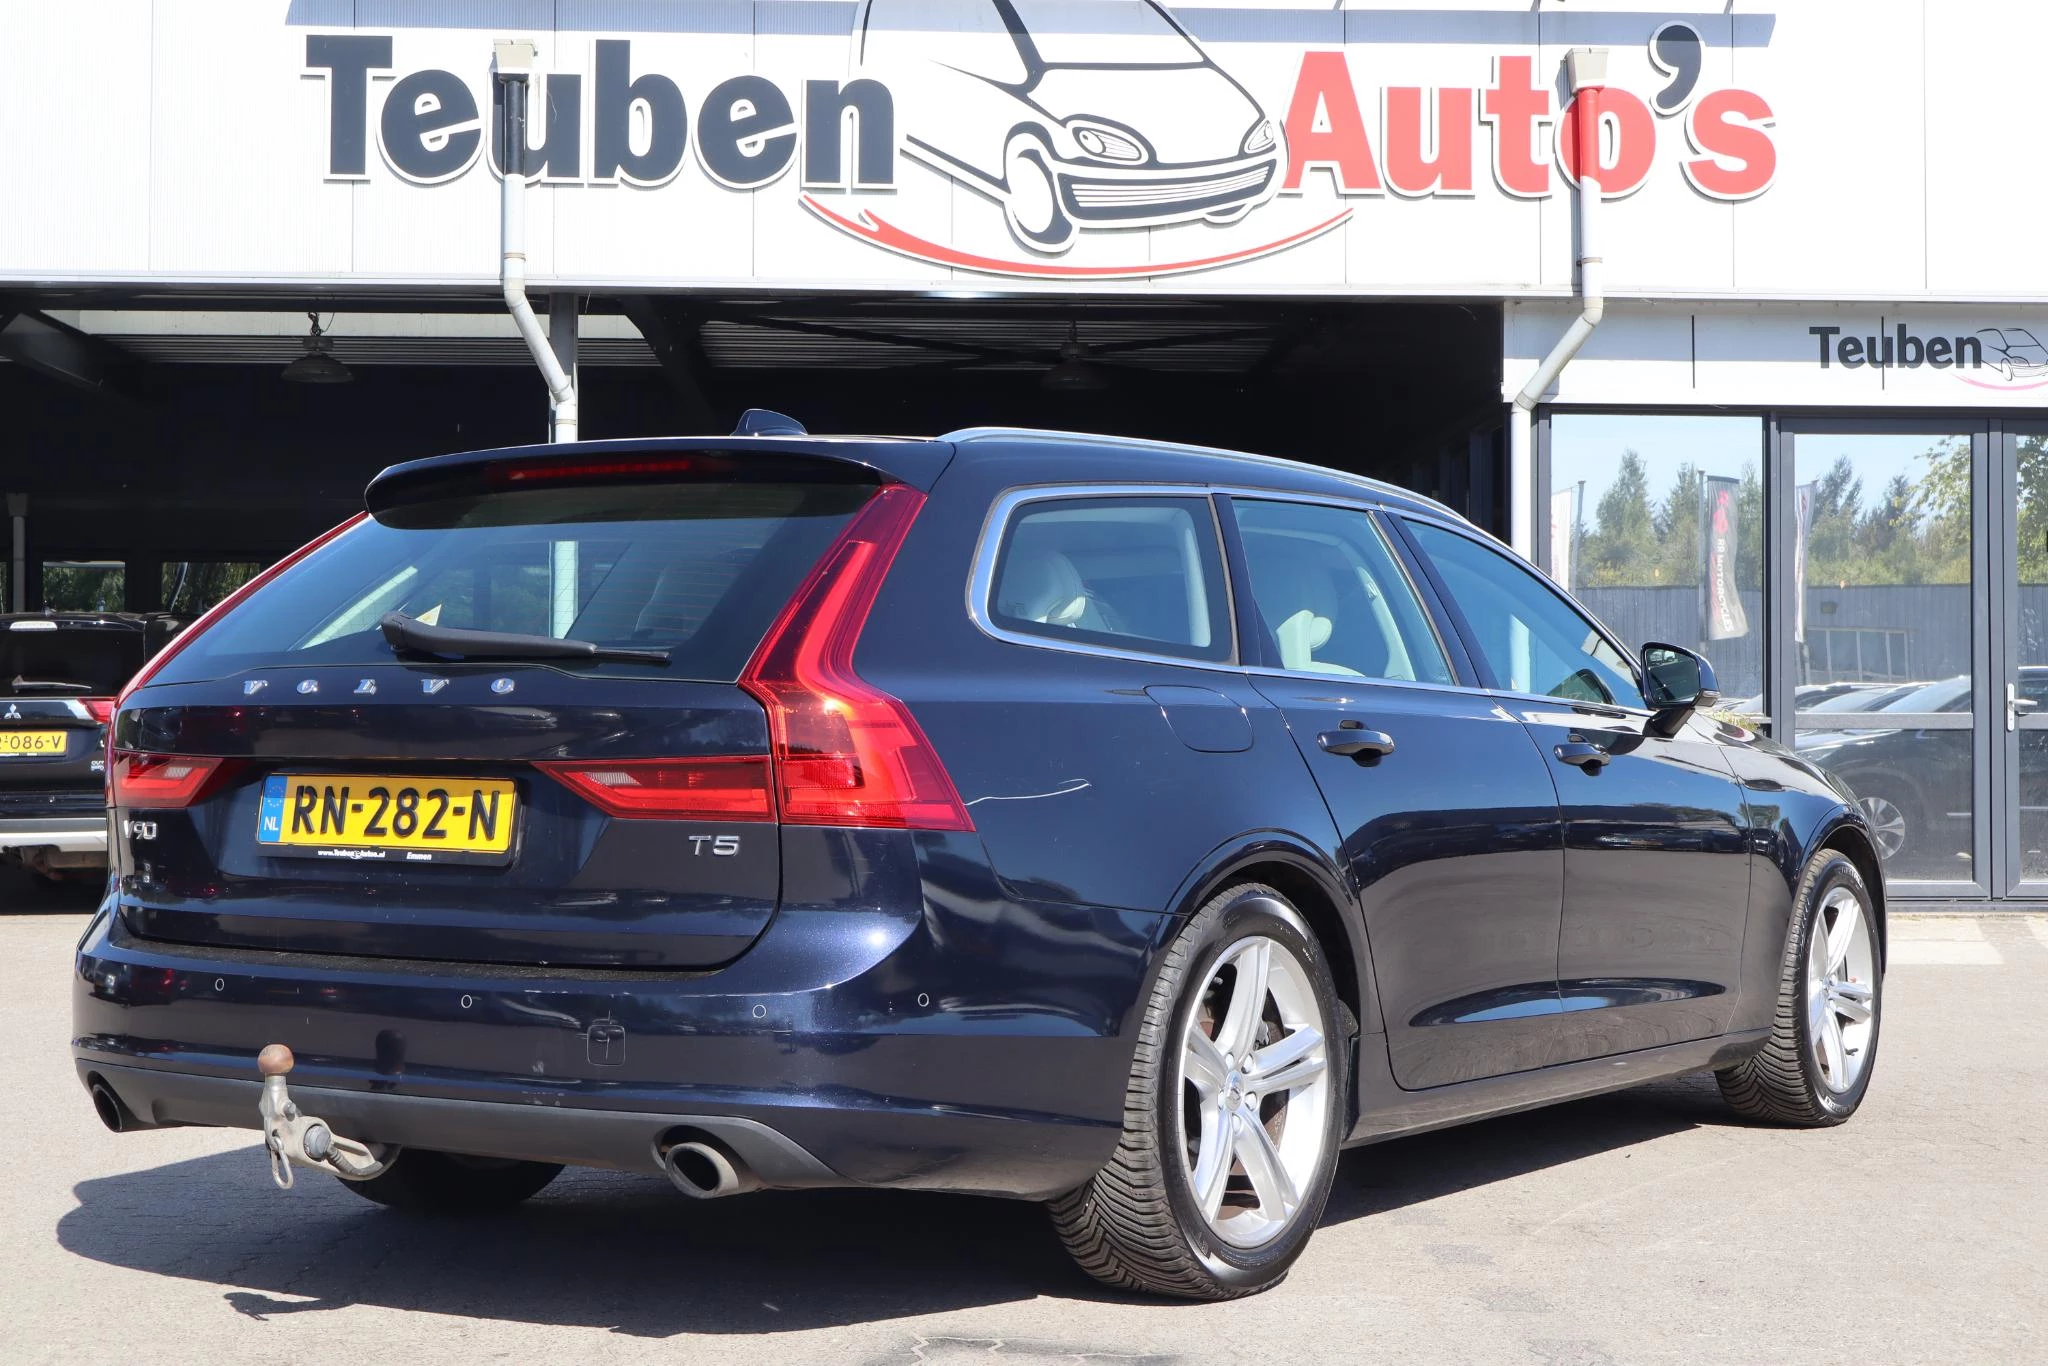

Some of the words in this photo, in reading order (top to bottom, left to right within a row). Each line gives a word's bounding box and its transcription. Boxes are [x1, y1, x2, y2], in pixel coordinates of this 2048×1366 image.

[304, 34, 894, 185] Teuben
[1284, 24, 1777, 196] Auto's
[1808, 323, 1983, 370] Teuben
[243, 678, 516, 695] VOLVO
[263, 816, 280, 831] NL
[291, 785, 501, 841] RN-282-N
[123, 820, 158, 840] V90
[688, 835, 740, 856] T5
